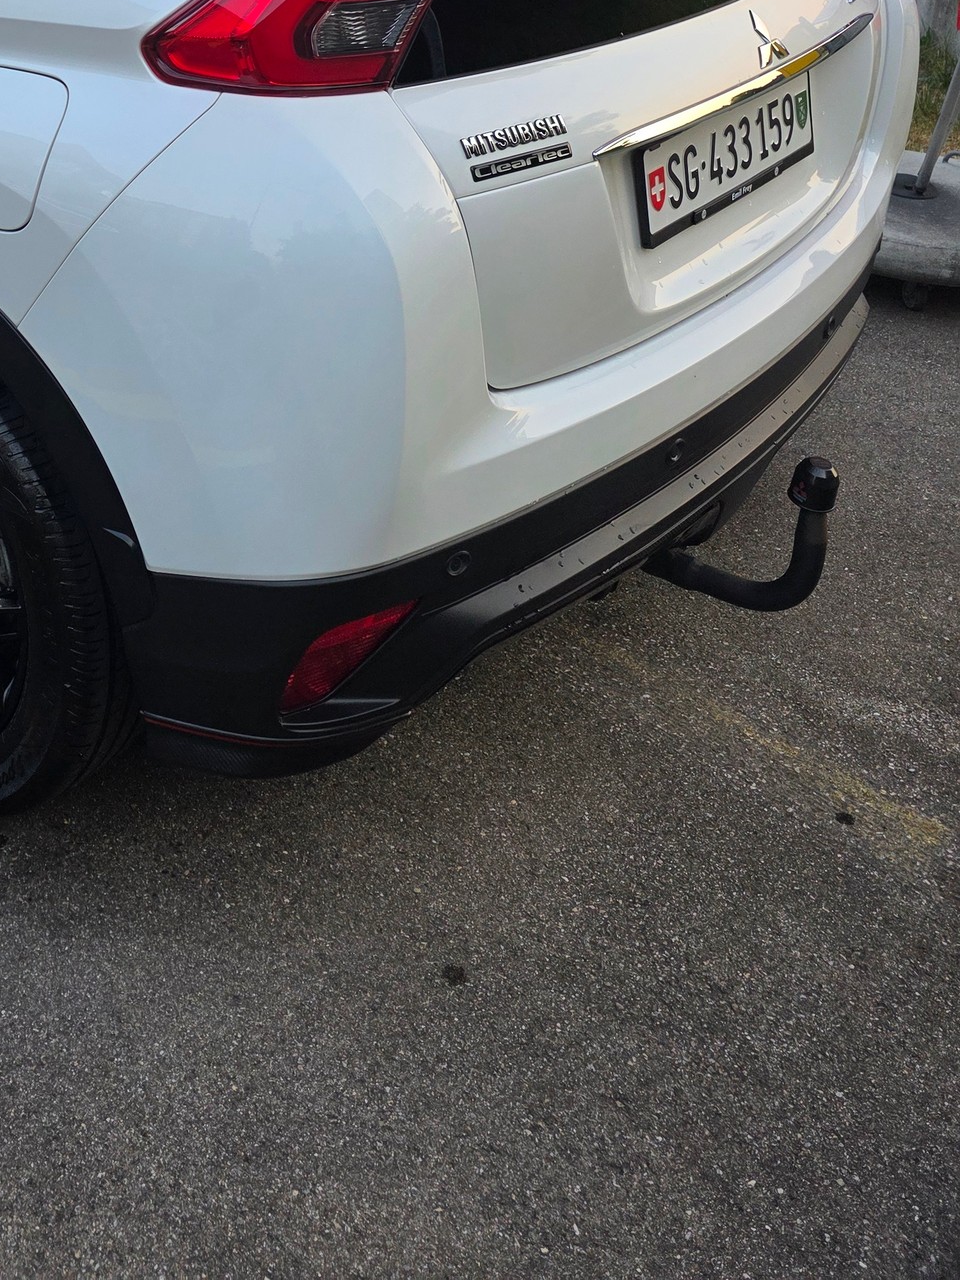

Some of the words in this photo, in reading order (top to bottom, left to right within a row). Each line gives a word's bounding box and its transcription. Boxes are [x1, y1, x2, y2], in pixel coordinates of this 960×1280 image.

[460, 113, 569, 160] MITSUBISHI
[472, 146, 572, 179] ClearTec
[731, 187, 742, 201] Emil
